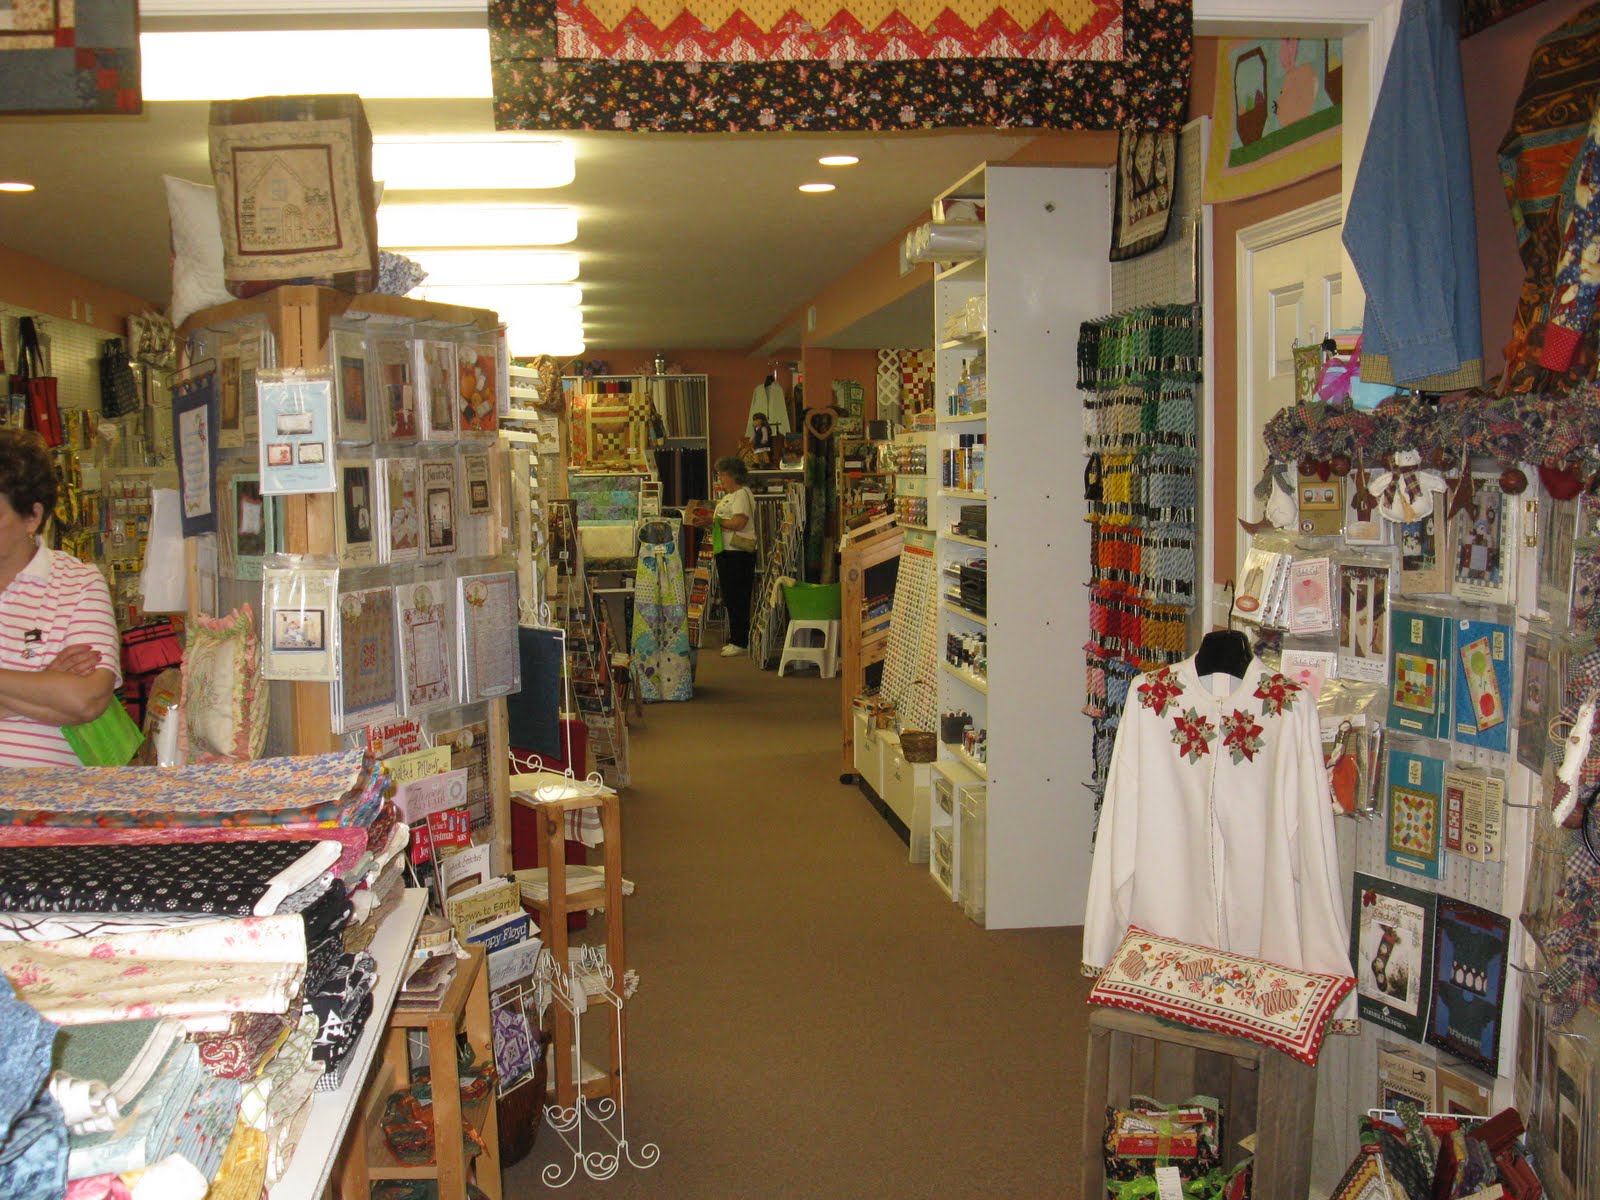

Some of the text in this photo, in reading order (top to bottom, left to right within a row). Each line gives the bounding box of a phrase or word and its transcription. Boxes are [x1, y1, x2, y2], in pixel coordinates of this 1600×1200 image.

[458, 898, 516, 924] Down to Earth
[503, 923, 528, 941] Floyd
